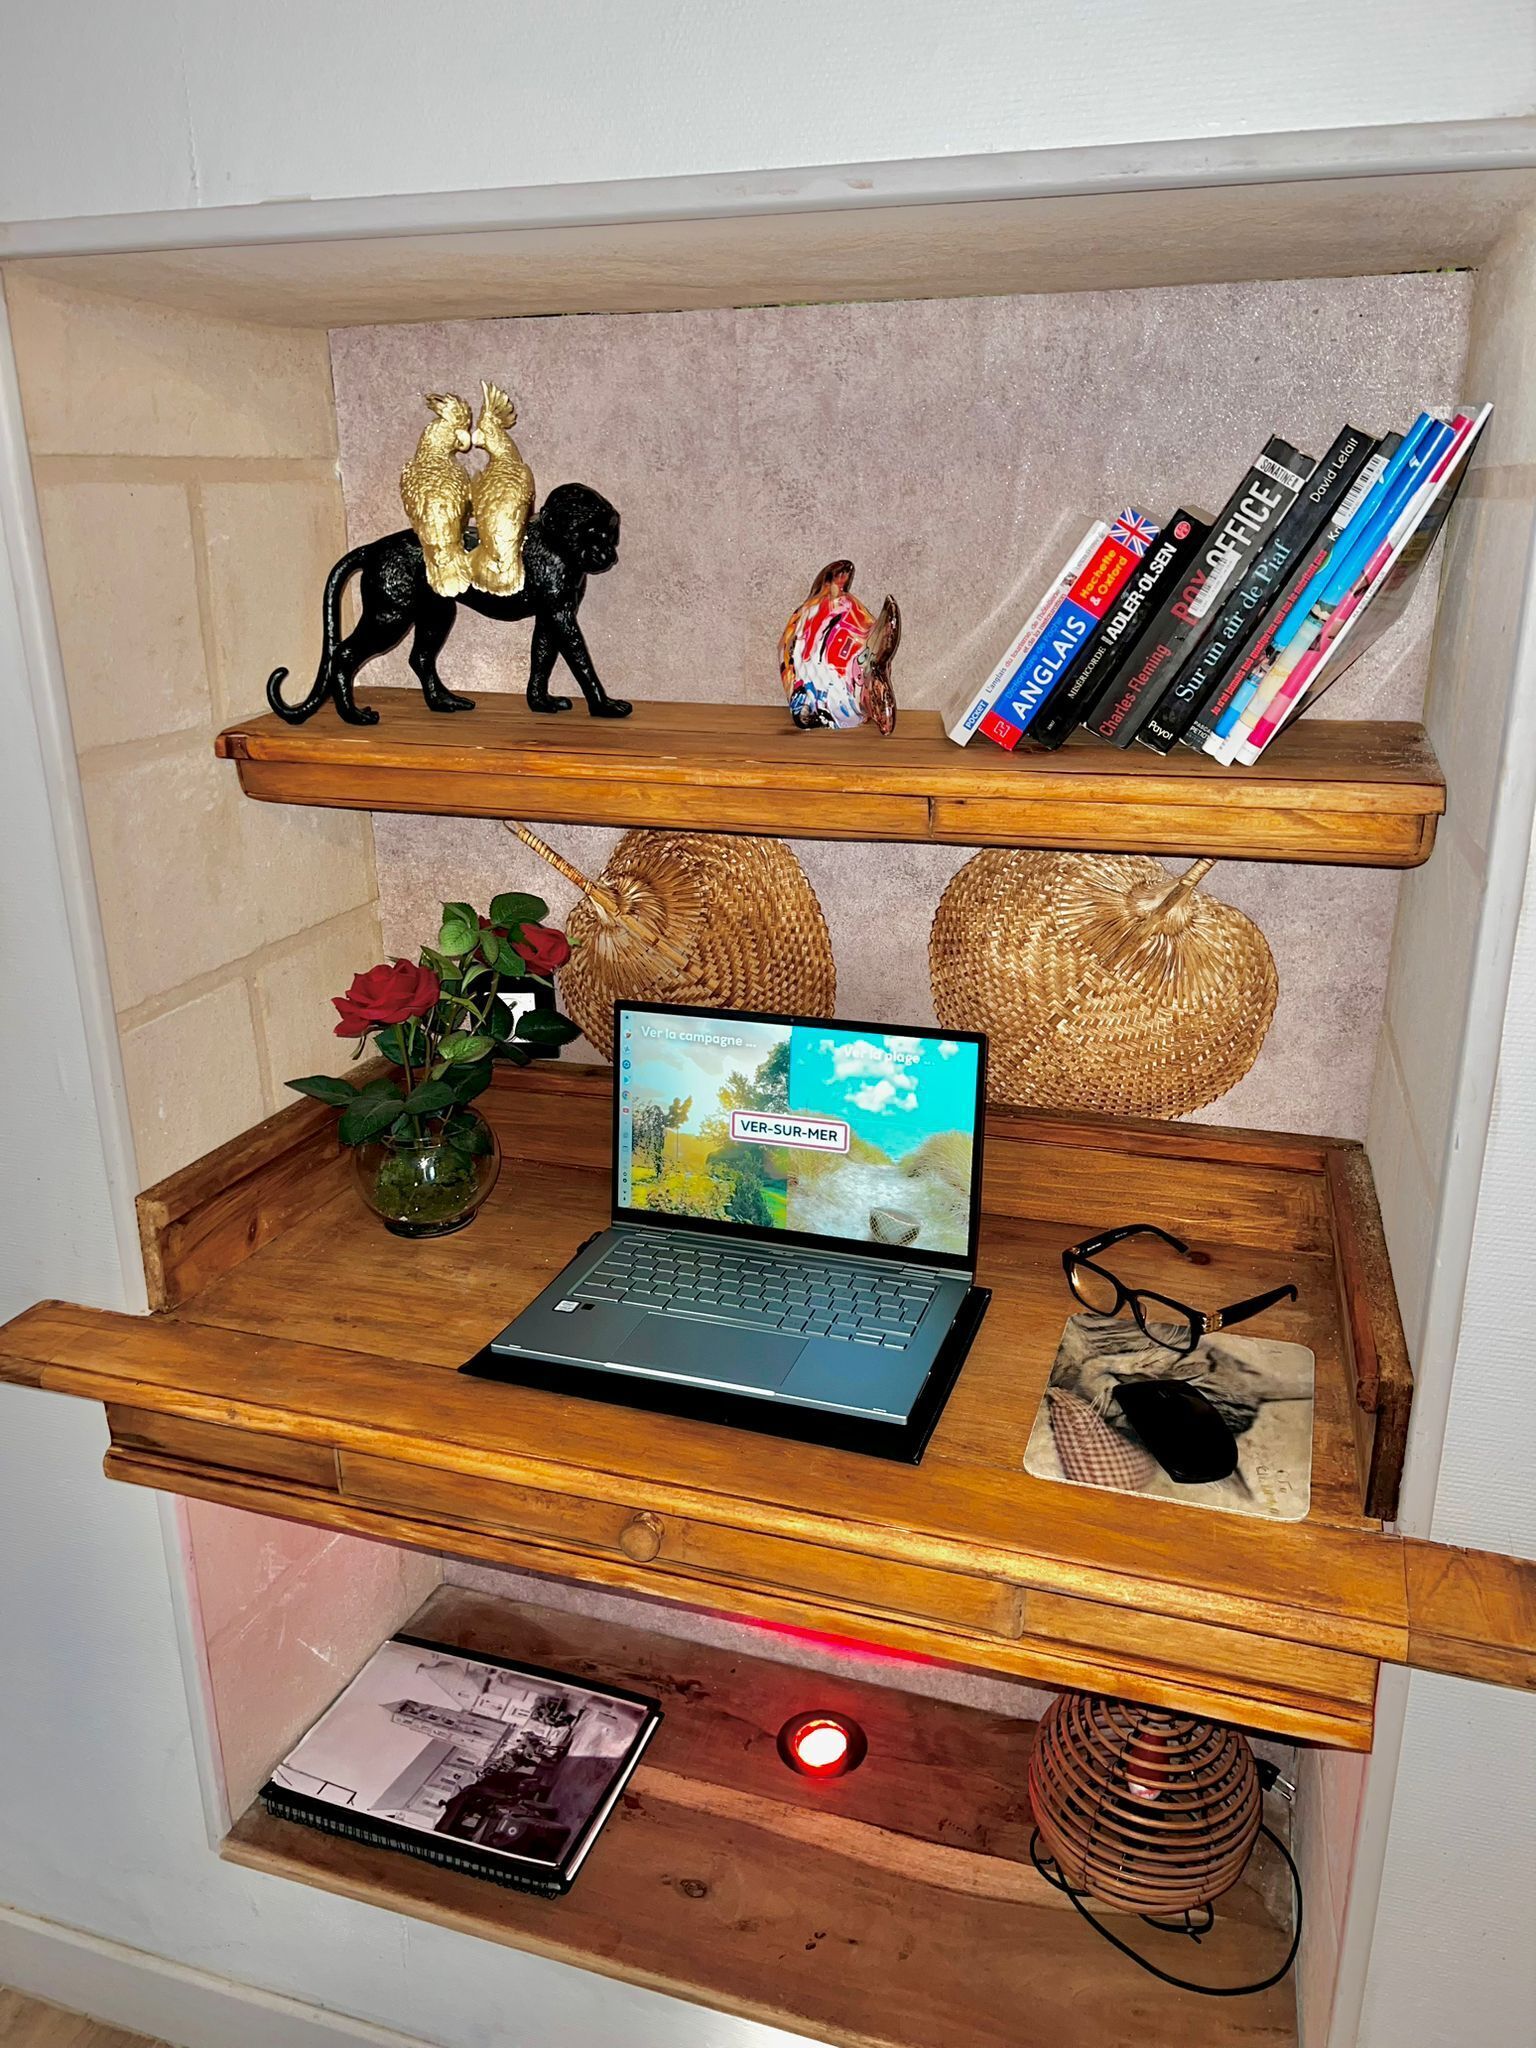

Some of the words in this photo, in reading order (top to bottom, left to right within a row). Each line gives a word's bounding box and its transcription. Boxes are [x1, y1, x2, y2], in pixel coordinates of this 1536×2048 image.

[1260, 457, 1294, 487] SONATINE
[1309, 468, 1338, 503] David
[1332, 436, 1360, 469] Lelait
[1079, 548, 1118, 598] Hachette
[1090, 595, 1101, 606] &
[1096, 555, 1129, 596] Oxford
[1105, 542, 1178, 641] ADLER-OLSEN
[1174, 664, 1209, 703] Sur
[1202, 639, 1227, 667] un
[1217, 608, 1247, 640] air
[1236, 580, 1264, 610] de
[1252, 537, 1294, 586] Piaf
[1224, 668, 1247, 695] jamais
[1248, 622, 1279, 659] quelqu'un
[1272, 610, 1287, 625] qui
[1313, 549, 1329, 566] pas
[985, 666, 1007, 694] L'anglais
[1003, 657, 1013, 667] du
[1030, 619, 1039, 629] de
[1004, 653, 1039, 699] Dictionnaire
[1035, 641, 1047, 654] de
[1042, 615, 1064, 642] Poche
[1010, 615, 1087, 720] ANGLAIS
[1067, 645, 1107, 699] MISÉRICORDE
[1098, 690, 1137, 737] Charles
[1128, 642, 1173, 694] Fleming
[1148, 720, 1174, 741] Payot
[1192, 720, 1212, 734] PASCA
[641, 1026, 662, 1038] Ver
[666, 1029, 676, 1040] la
[679, 1032, 743, 1047] campagne
[885, 1051, 920, 1066] plage
[740, 1119, 838, 1142] VER-SUR-MER
